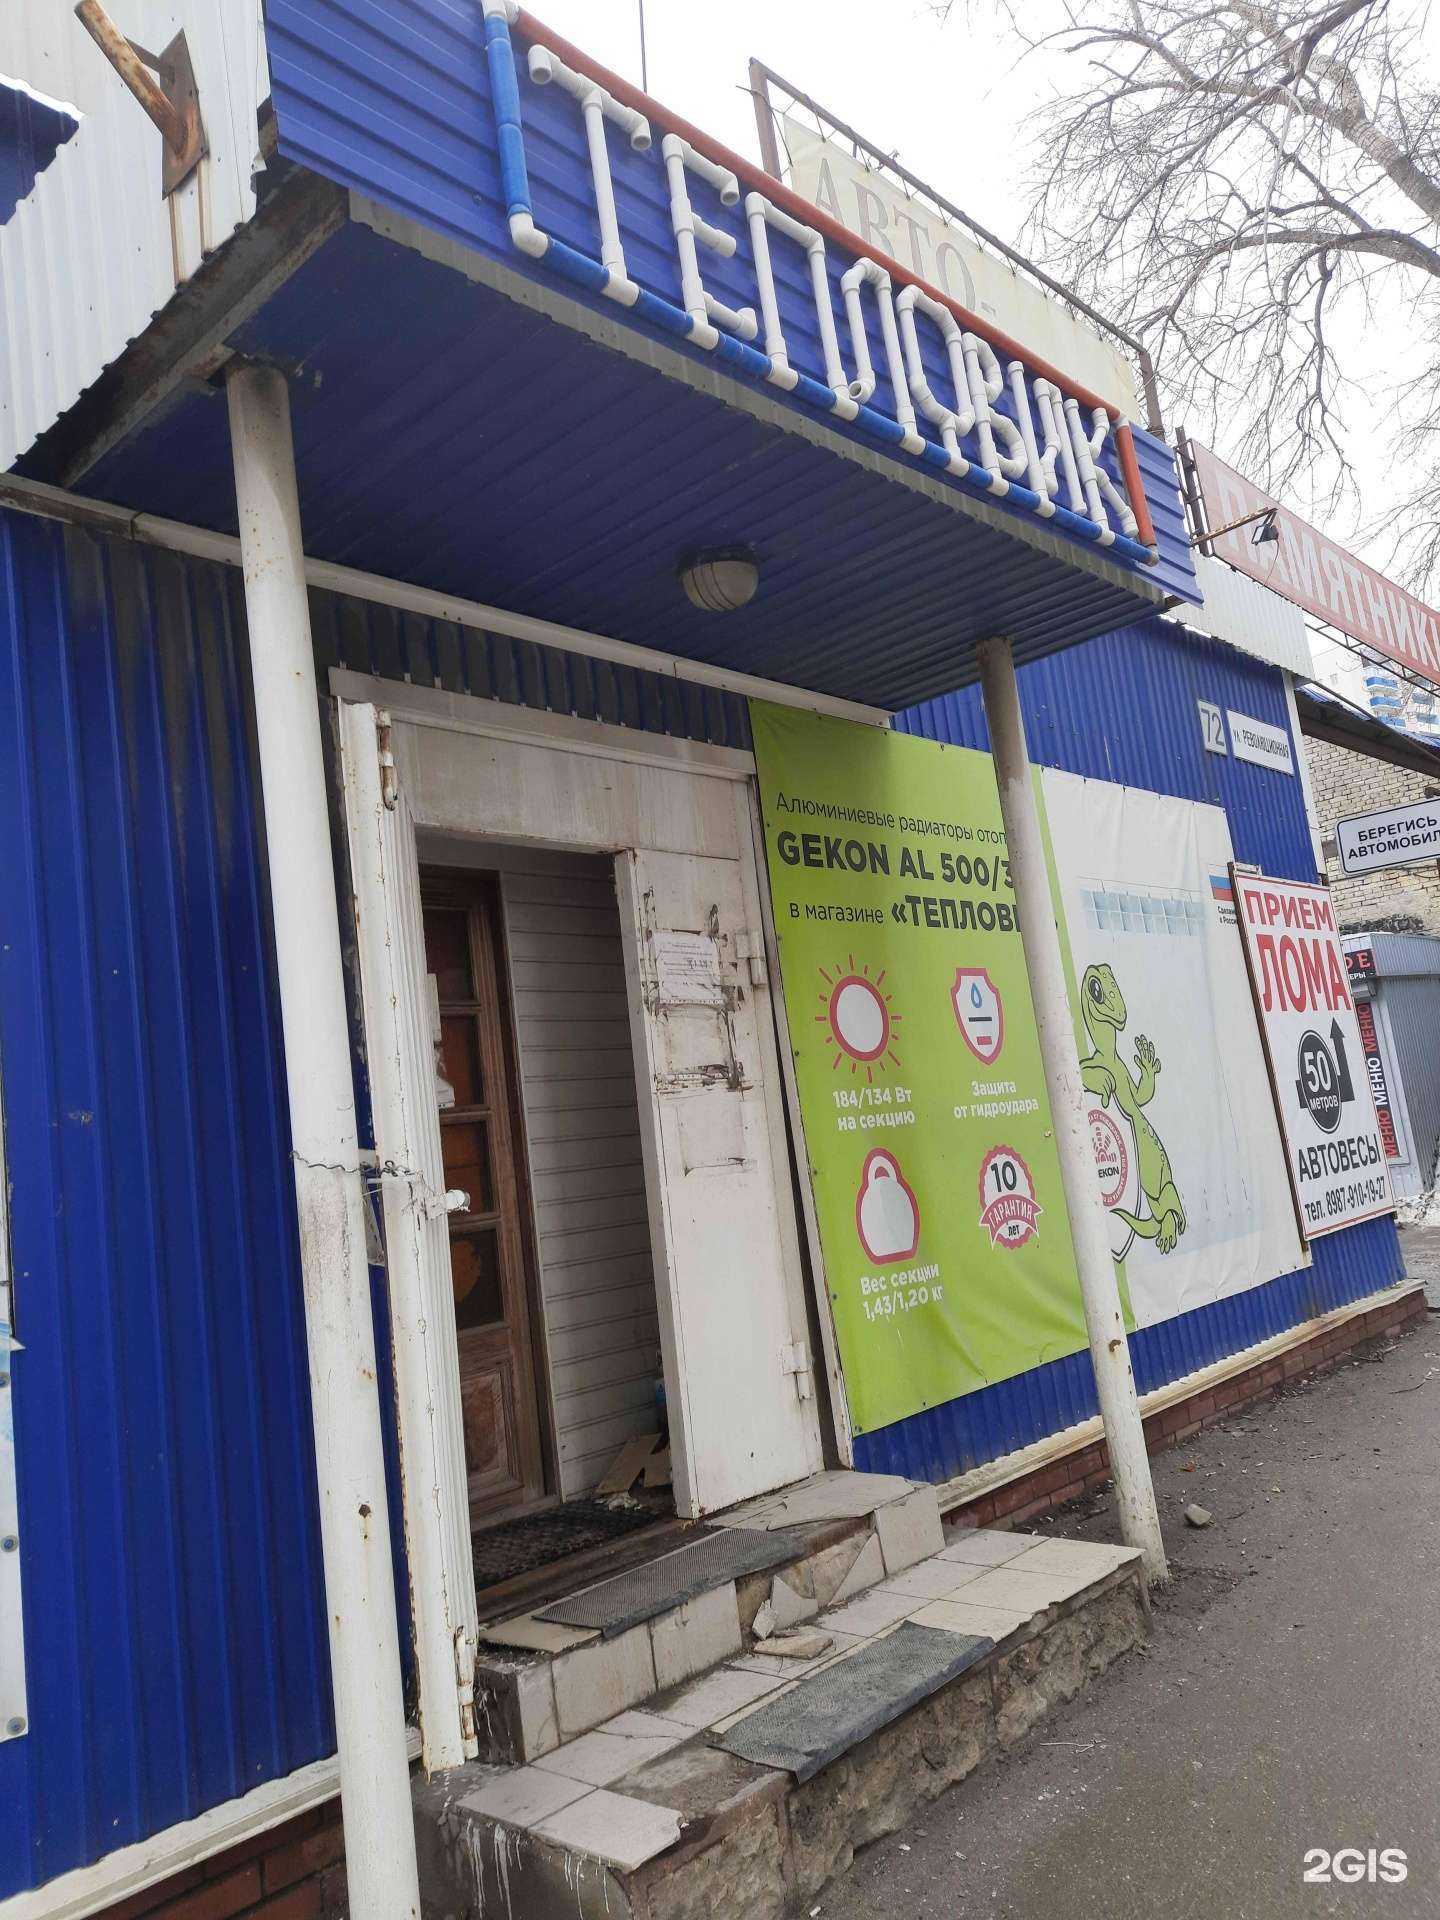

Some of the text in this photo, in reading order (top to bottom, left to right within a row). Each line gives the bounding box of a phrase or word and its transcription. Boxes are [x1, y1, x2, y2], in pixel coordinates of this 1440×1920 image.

[529, 43, 1140, 546] ТЕПЛОВИК
[1216, 472, 1440, 673] ПАМЯТНИК
[1201, 708, 1225, 747] 72
[776, 791, 895, 829] Алюминиевые
[899, 815, 973, 842] радиаторы
[1357, 816, 1438, 842] БЕРЕГИСЬ
[777, 830, 890, 876] GEKON
[899, 846, 935, 881] AL
[789, 902, 801, 918] в
[805, 903, 884, 924] магазине
[1243, 889, 1335, 931] ПРИЕМ
[1255, 933, 1351, 1013] ЛОМА
[971, 1080, 1017, 1097] Защита
[1303, 1049, 1333, 1093] 50
[1367, 1056, 1389, 1106] МЕНЮ
[833, 1088, 912, 1109] 184/134 Вт
[954, 1097, 1039, 1119] от гидроудара
[1309, 1096, 1339, 1112] метров
[838, 1110, 915, 1131] на секцию
[1299, 1133, 1381, 1182] АВТОВЕСЫ
[991, 1161, 1017, 1193] 10
[988, 1199, 1033, 1229] ГАРАНТИЯ
[1304, 1175, 1386, 1223] тел. 8987-910-19-27
[861, 1264, 939, 1295] Вес секции
[932, 1285, 944, 1300] кг
